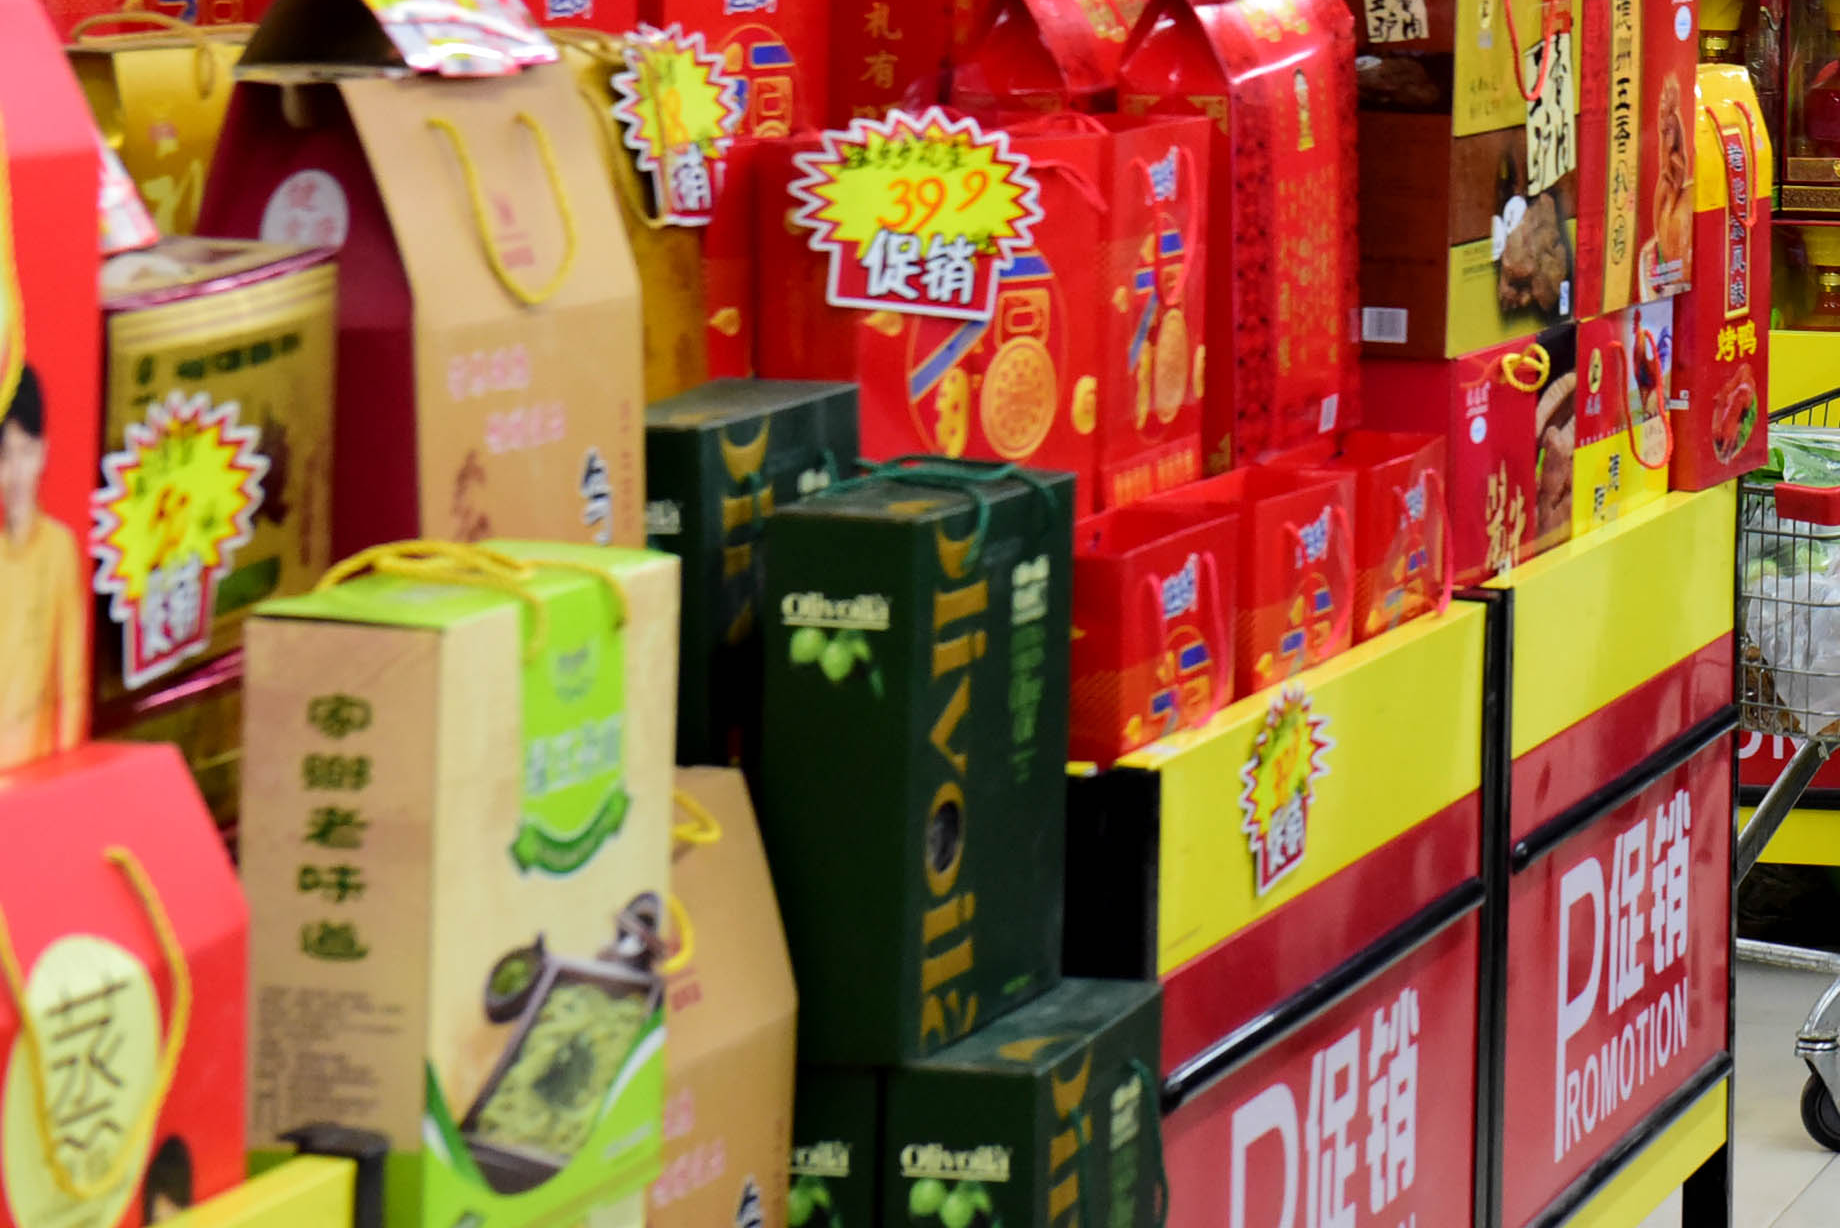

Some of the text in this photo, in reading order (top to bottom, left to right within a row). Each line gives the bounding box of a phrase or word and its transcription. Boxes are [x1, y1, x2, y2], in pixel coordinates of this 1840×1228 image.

[862, 228, 976, 304] 促销
[1715, 320, 1758, 363] 烤鸭
[1608, 788, 1692, 1016] 促销
[1306, 986, 1421, 1228] 促销
